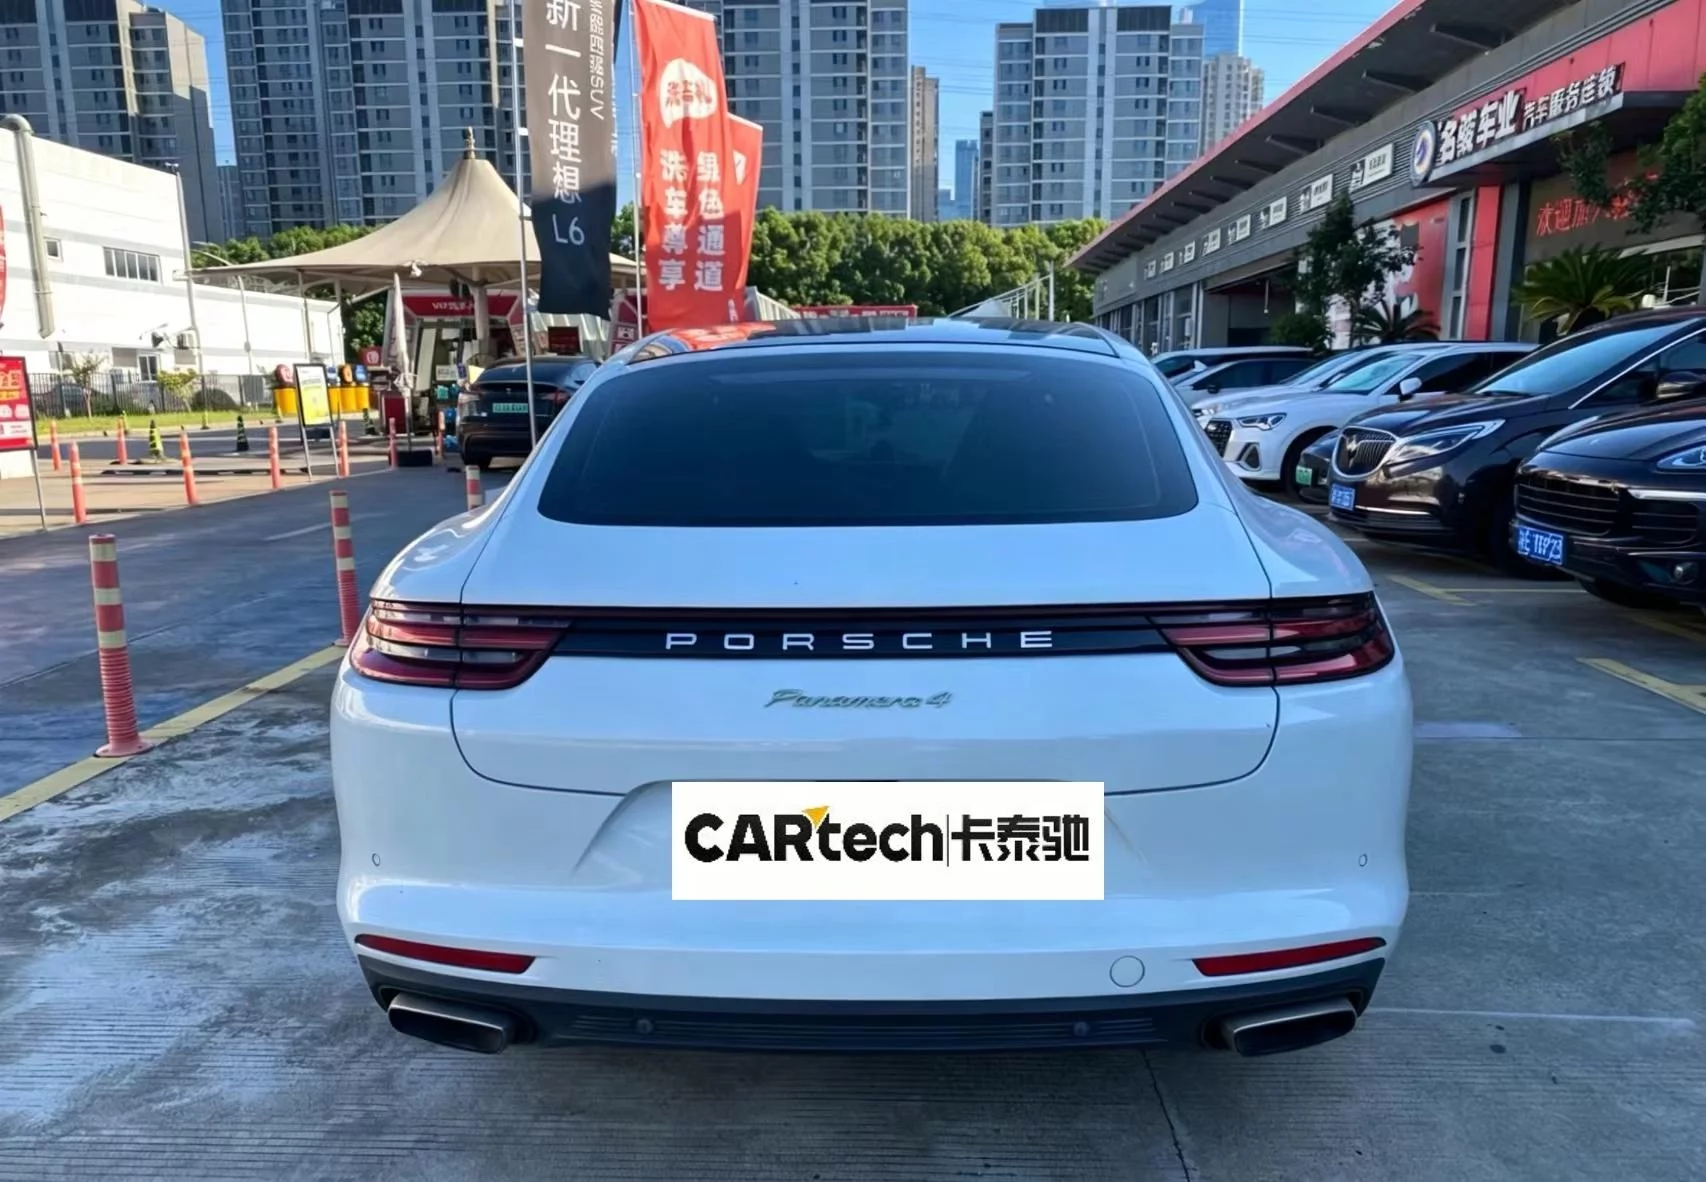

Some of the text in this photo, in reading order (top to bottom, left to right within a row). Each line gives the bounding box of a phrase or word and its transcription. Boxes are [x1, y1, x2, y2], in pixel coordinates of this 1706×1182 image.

[545, 0, 585, 246] 新一代理想 L6
[657, 148, 689, 292] 洗车尊享
[664, 630, 1053, 651] PORSCHE
[763, 688, 955, 709] Panamera 4
